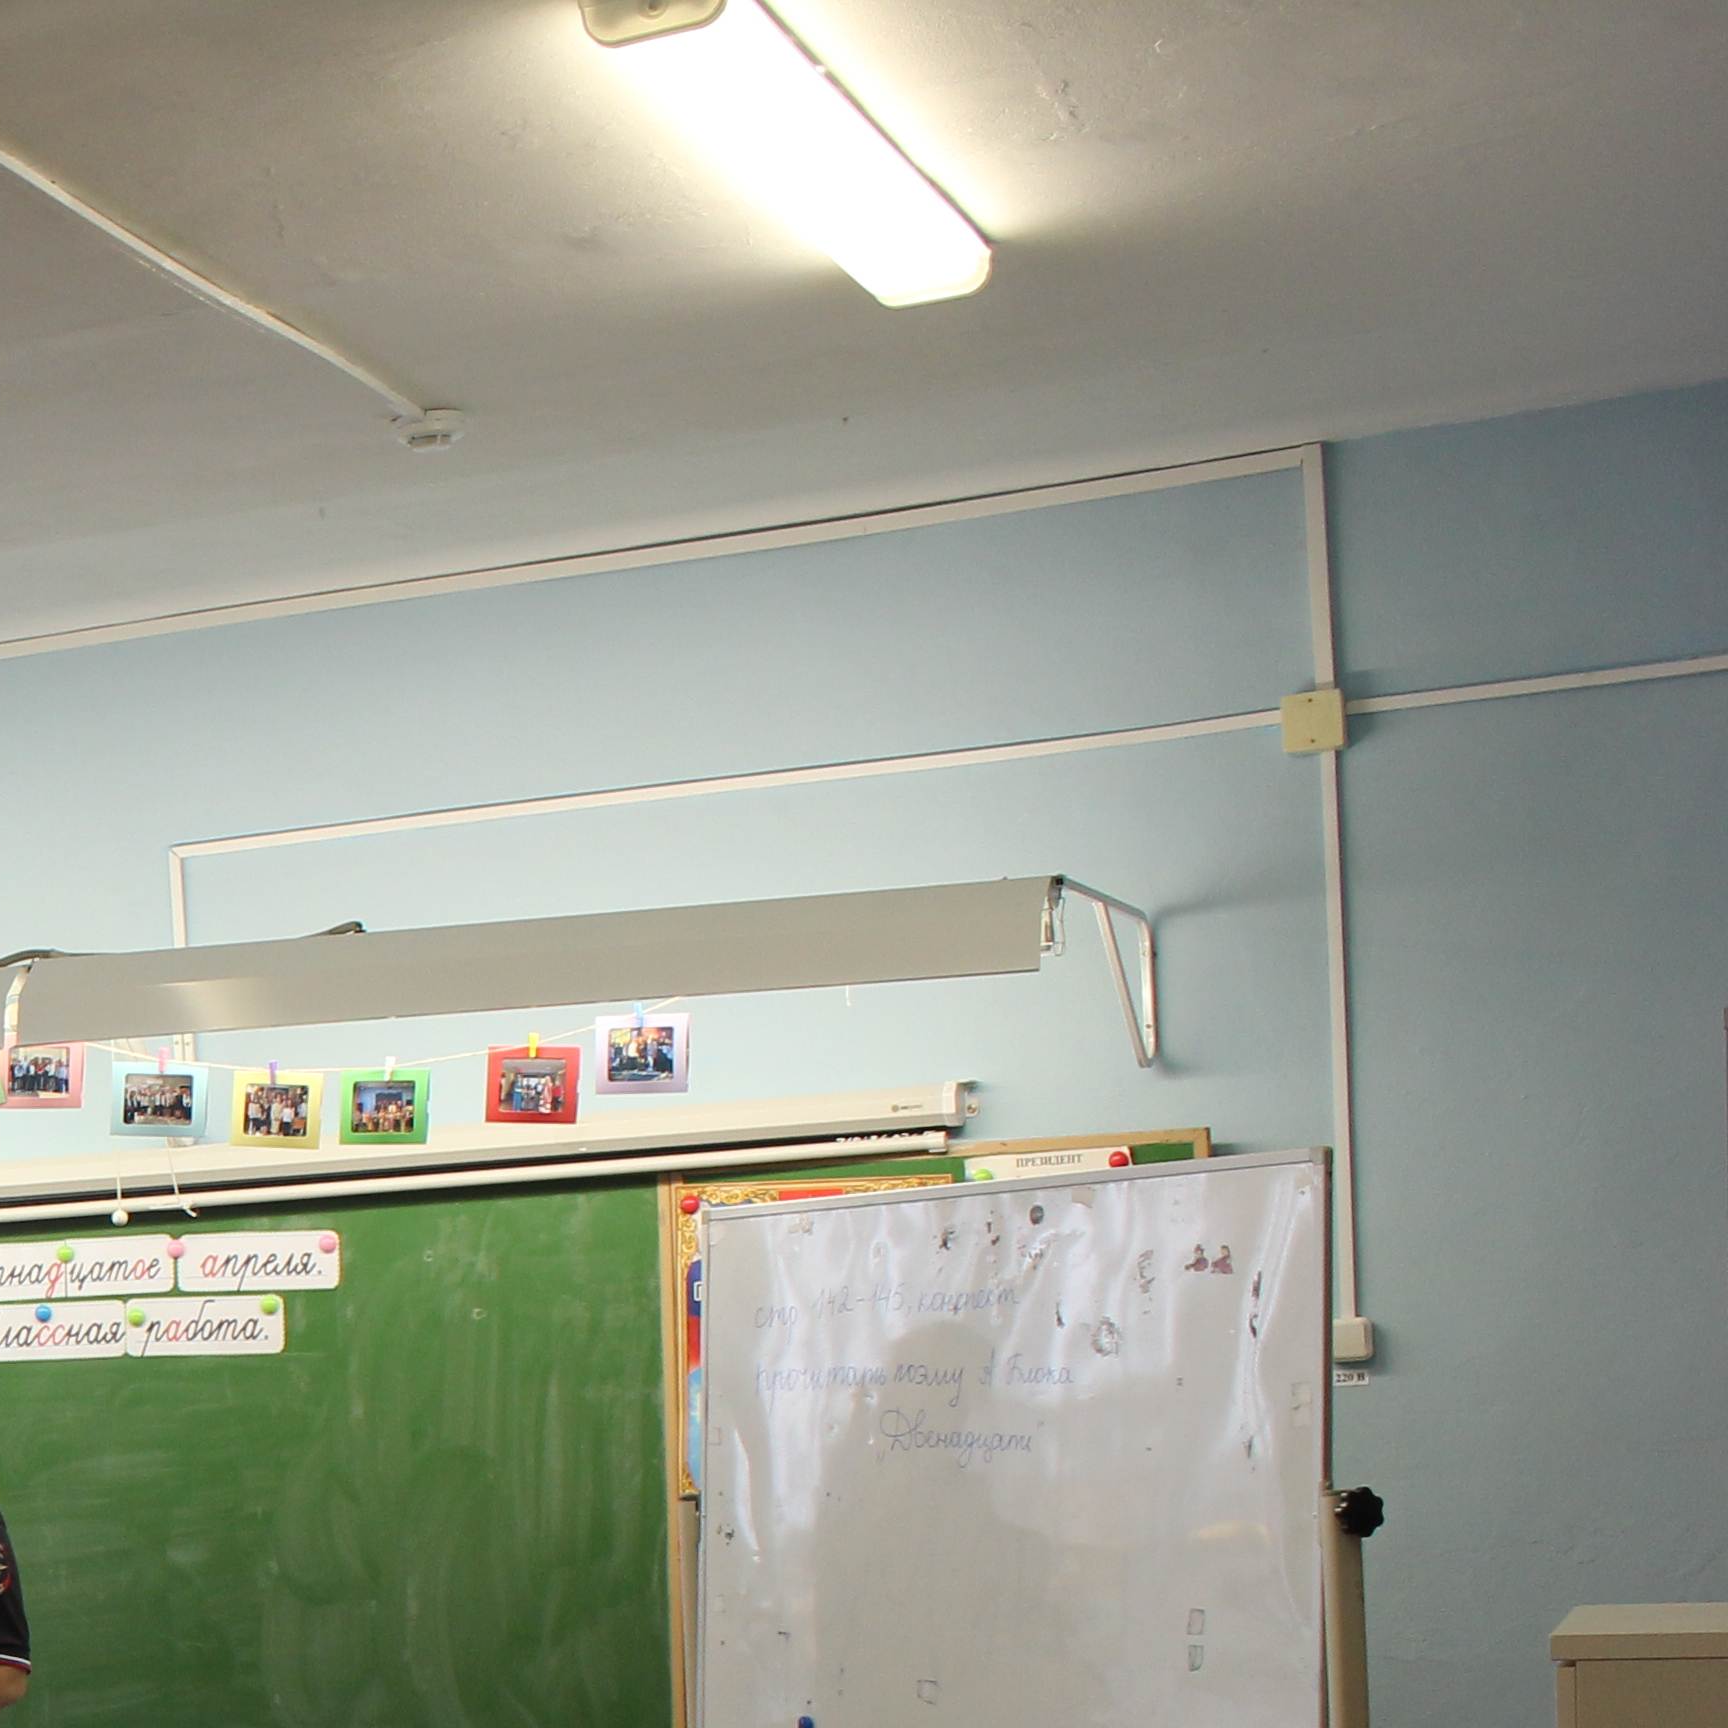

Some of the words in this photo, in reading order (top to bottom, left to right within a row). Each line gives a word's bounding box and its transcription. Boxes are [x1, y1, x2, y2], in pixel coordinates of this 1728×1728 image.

[1016, 1153, 1083, 1168] ПРЕЗИДЕНТ
[201, 1250, 324, 1291] апреля.
[141, 1299, 270, 1357] работа.
[893, 1362, 965, 1408] поэму
